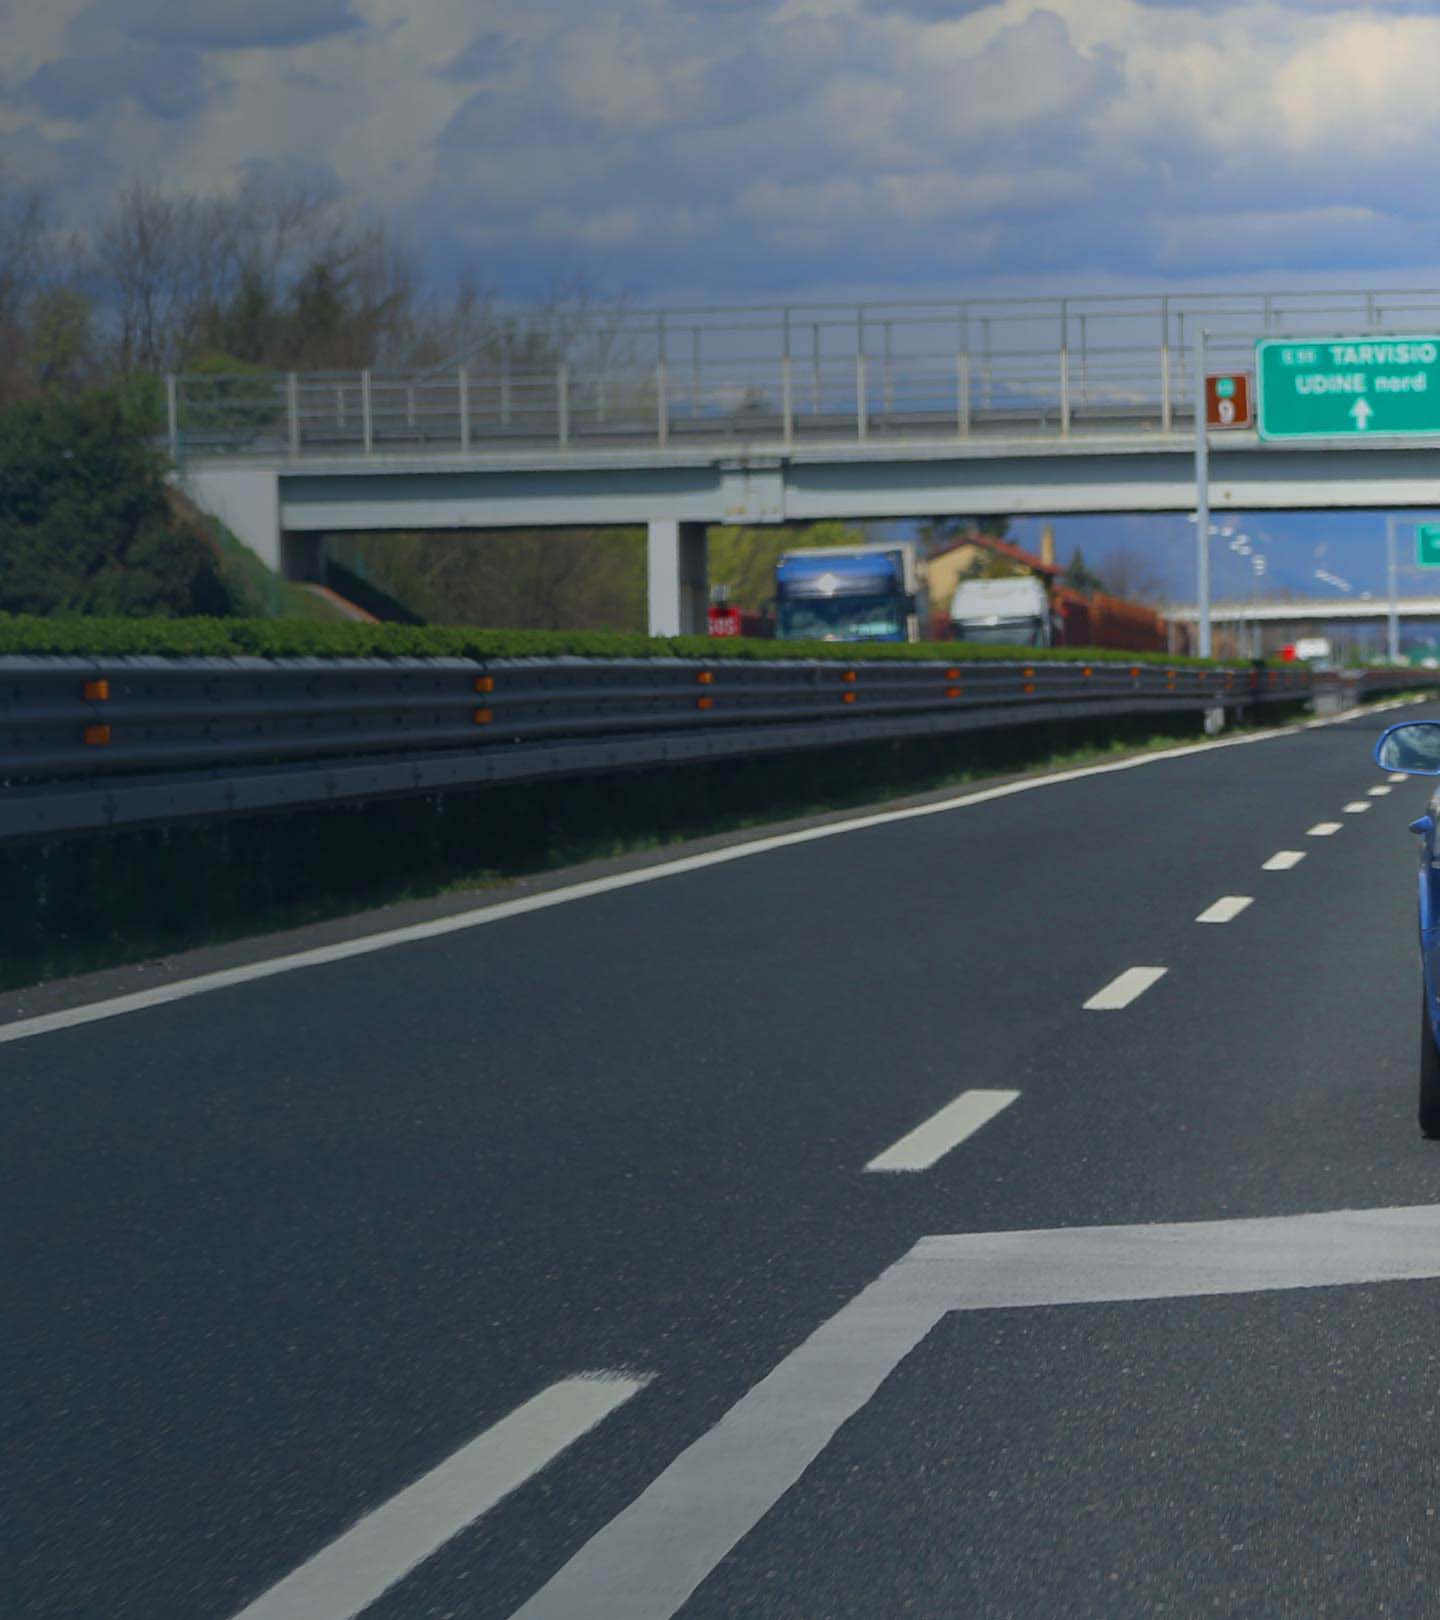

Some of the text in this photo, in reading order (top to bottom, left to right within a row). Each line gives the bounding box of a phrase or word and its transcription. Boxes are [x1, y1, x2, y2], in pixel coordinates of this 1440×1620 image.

[1329, 342, 1437, 365] TARVISIO
[1295, 371, 1427, 394] UDINE nord
